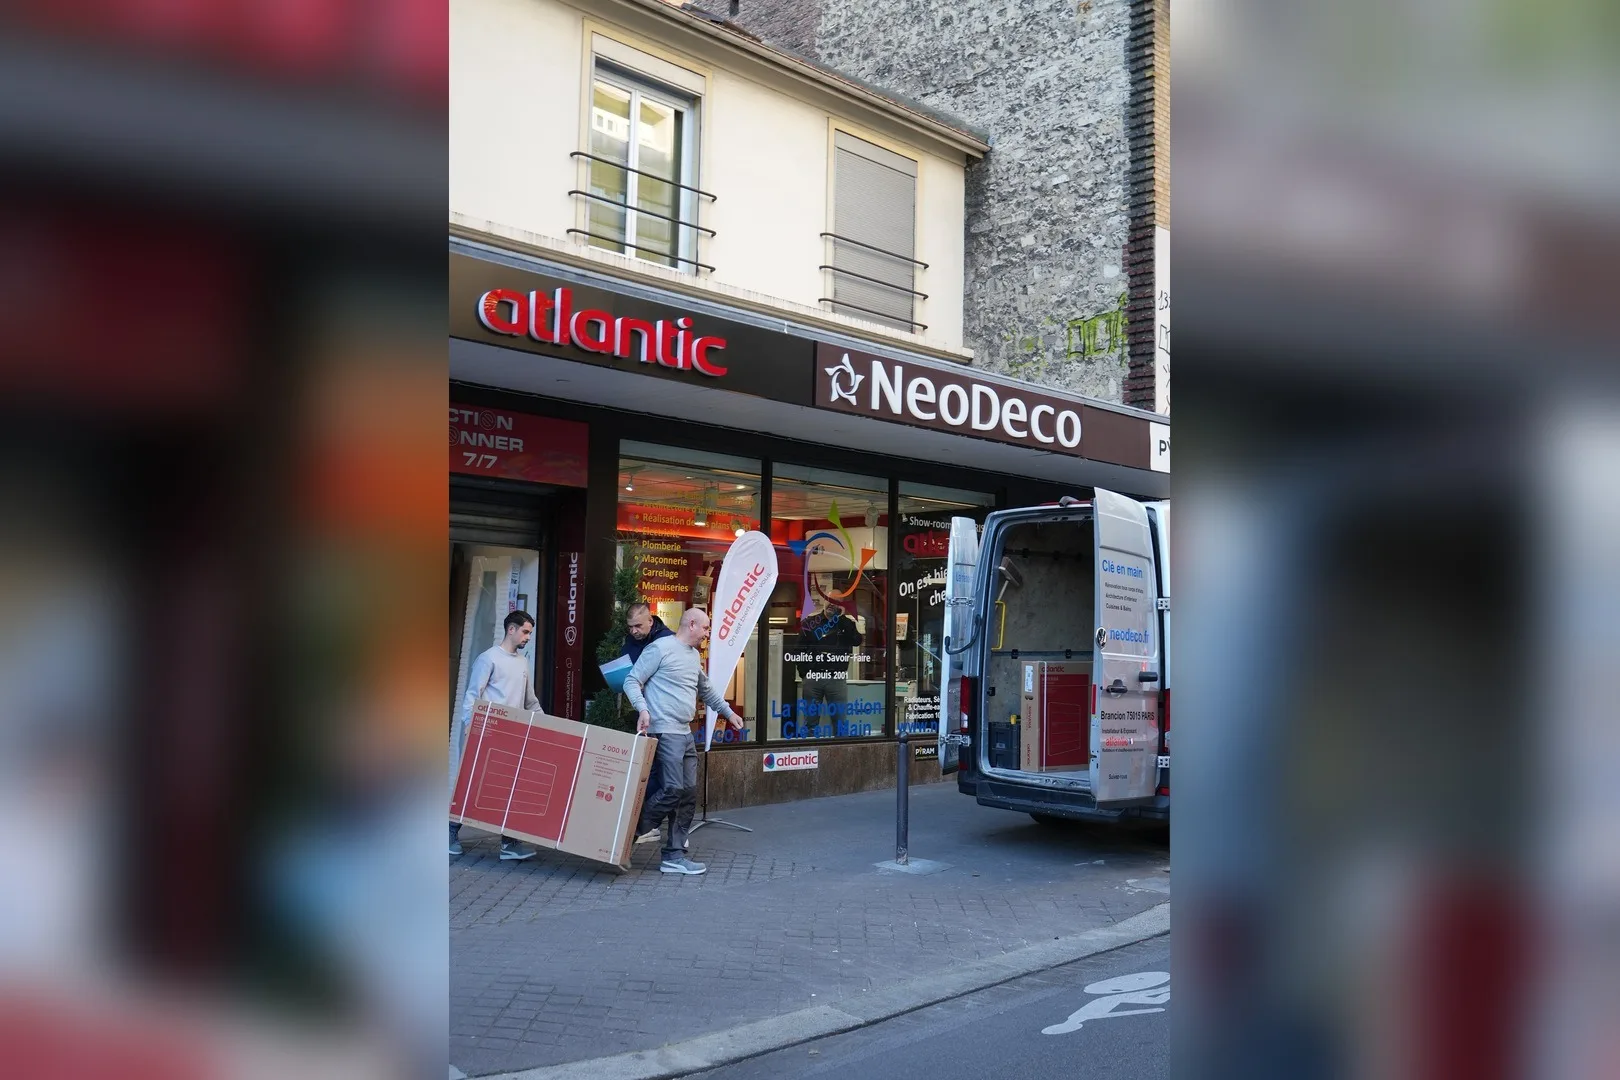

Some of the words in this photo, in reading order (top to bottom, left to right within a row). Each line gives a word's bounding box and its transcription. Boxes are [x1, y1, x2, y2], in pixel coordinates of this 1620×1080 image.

[477, 287, 728, 377] atlantic
[871, 361, 1082, 448] NeoDeco
[463, 452, 498, 469] 7/7
[642, 512, 684, 526] Réalisation
[711, 519, 730, 530] plans
[642, 540, 681, 552] Plomberie
[642, 554, 688, 566] Maçonnerie
[642, 567, 679, 579] Carrelage
[1102, 559, 1115, 574] Clé
[1116, 565, 1126, 575] en
[1127, 566, 1143, 579] main
[567, 551, 578, 624] atlantic
[642, 581, 689, 592] Menuiseries
[899, 582, 914, 596] On
[917, 573, 932, 589] est
[933, 567, 948, 580] bie
[718, 563, 765, 640] atlantic
[930, 589, 947, 606] che
[813, 614, 840, 641] Deco
[1109, 628, 1150, 644] neodeco.fr
[784, 652, 813, 662] Qualité
[815, 653, 824, 662] et
[826, 652, 871, 662] Savoir-Faire
[806, 669, 832, 682] depuis
[833, 670, 849, 680] 2001
[771, 700, 791, 719] La
[796, 697, 882, 718] Rénovation
[913, 703, 941, 711] Chauffe-ea
[905, 711, 935, 720] Fabrication
[1101, 710, 1127, 721] Brancion
[1126, 710, 1141, 721] 75015
[783, 720, 808, 739] Clé
[813, 724, 833, 738] en
[837, 719, 872, 737] Main
[607, 745, 620, 754] 000
[776, 753, 819, 767] atlantic
